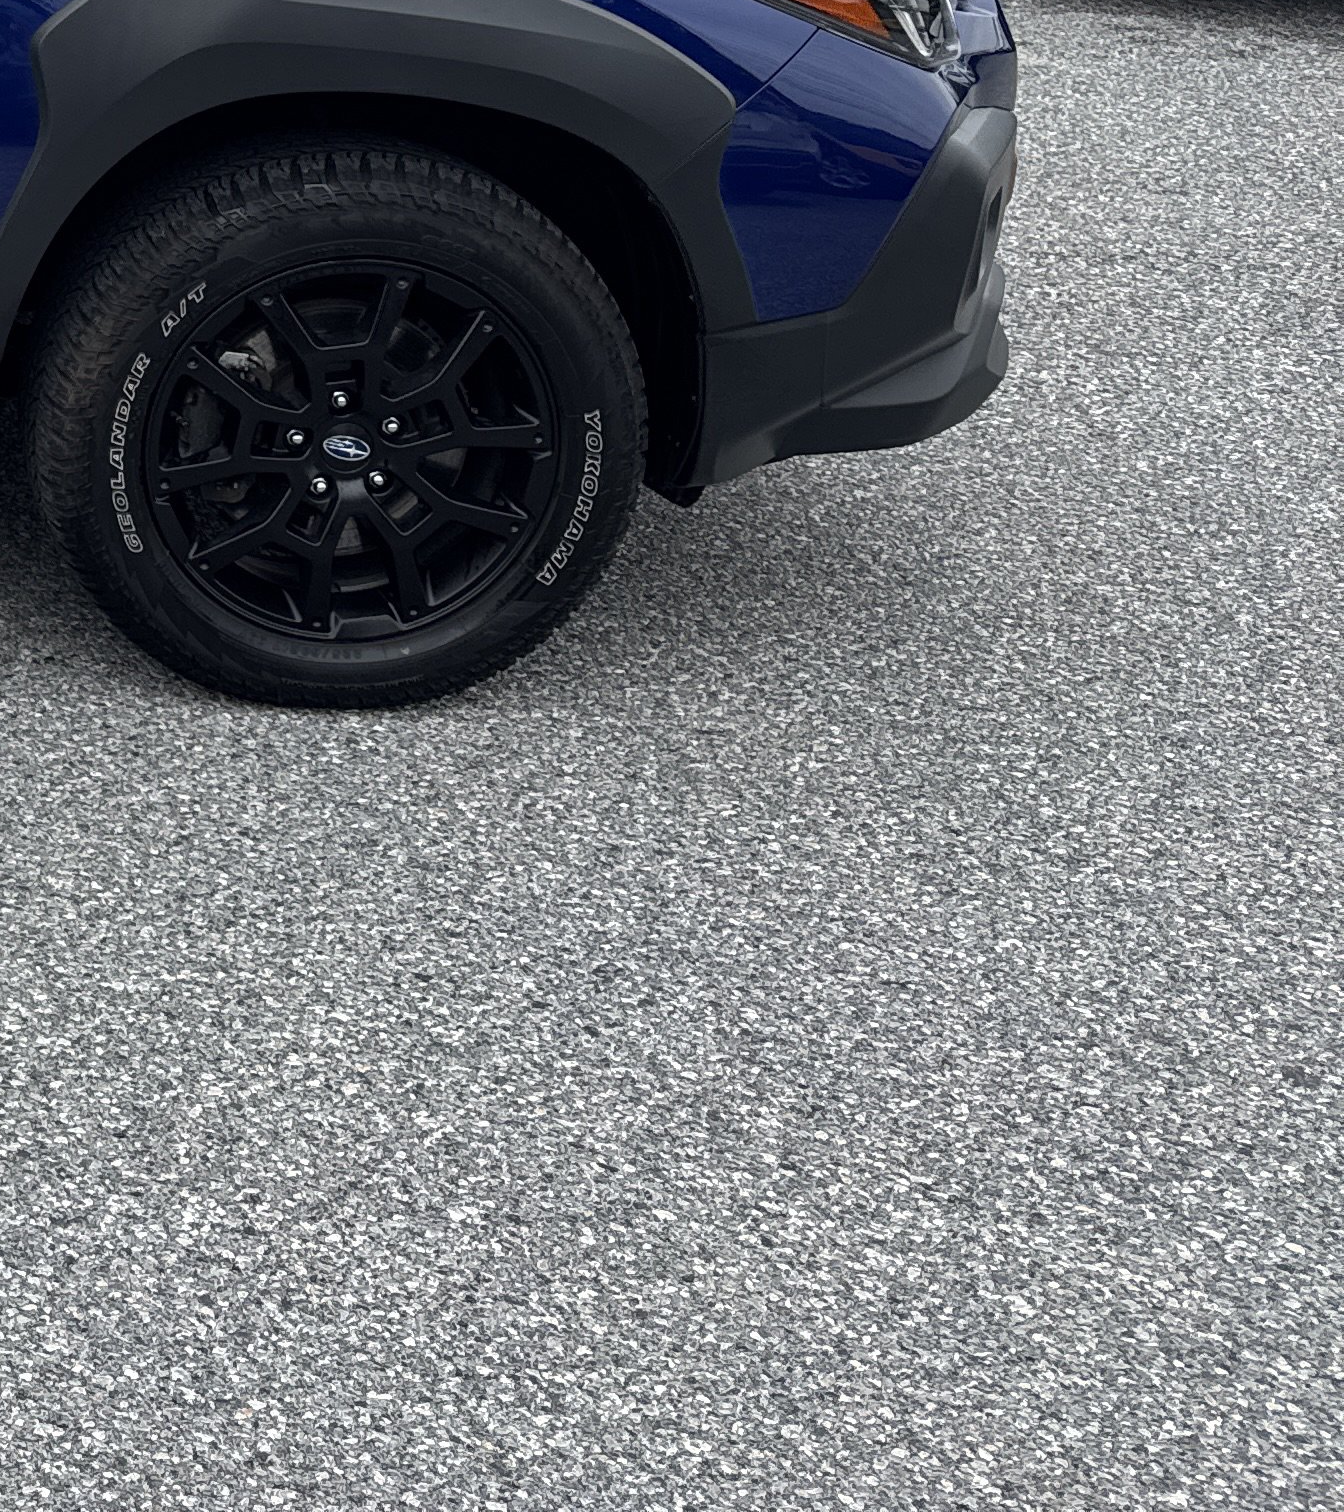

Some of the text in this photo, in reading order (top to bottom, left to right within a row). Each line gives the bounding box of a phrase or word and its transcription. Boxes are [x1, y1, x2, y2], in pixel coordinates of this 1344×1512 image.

[109, 282, 207, 554] GEOLANDAR A/T
[535, 408, 603, 586] YOKOHAMA
